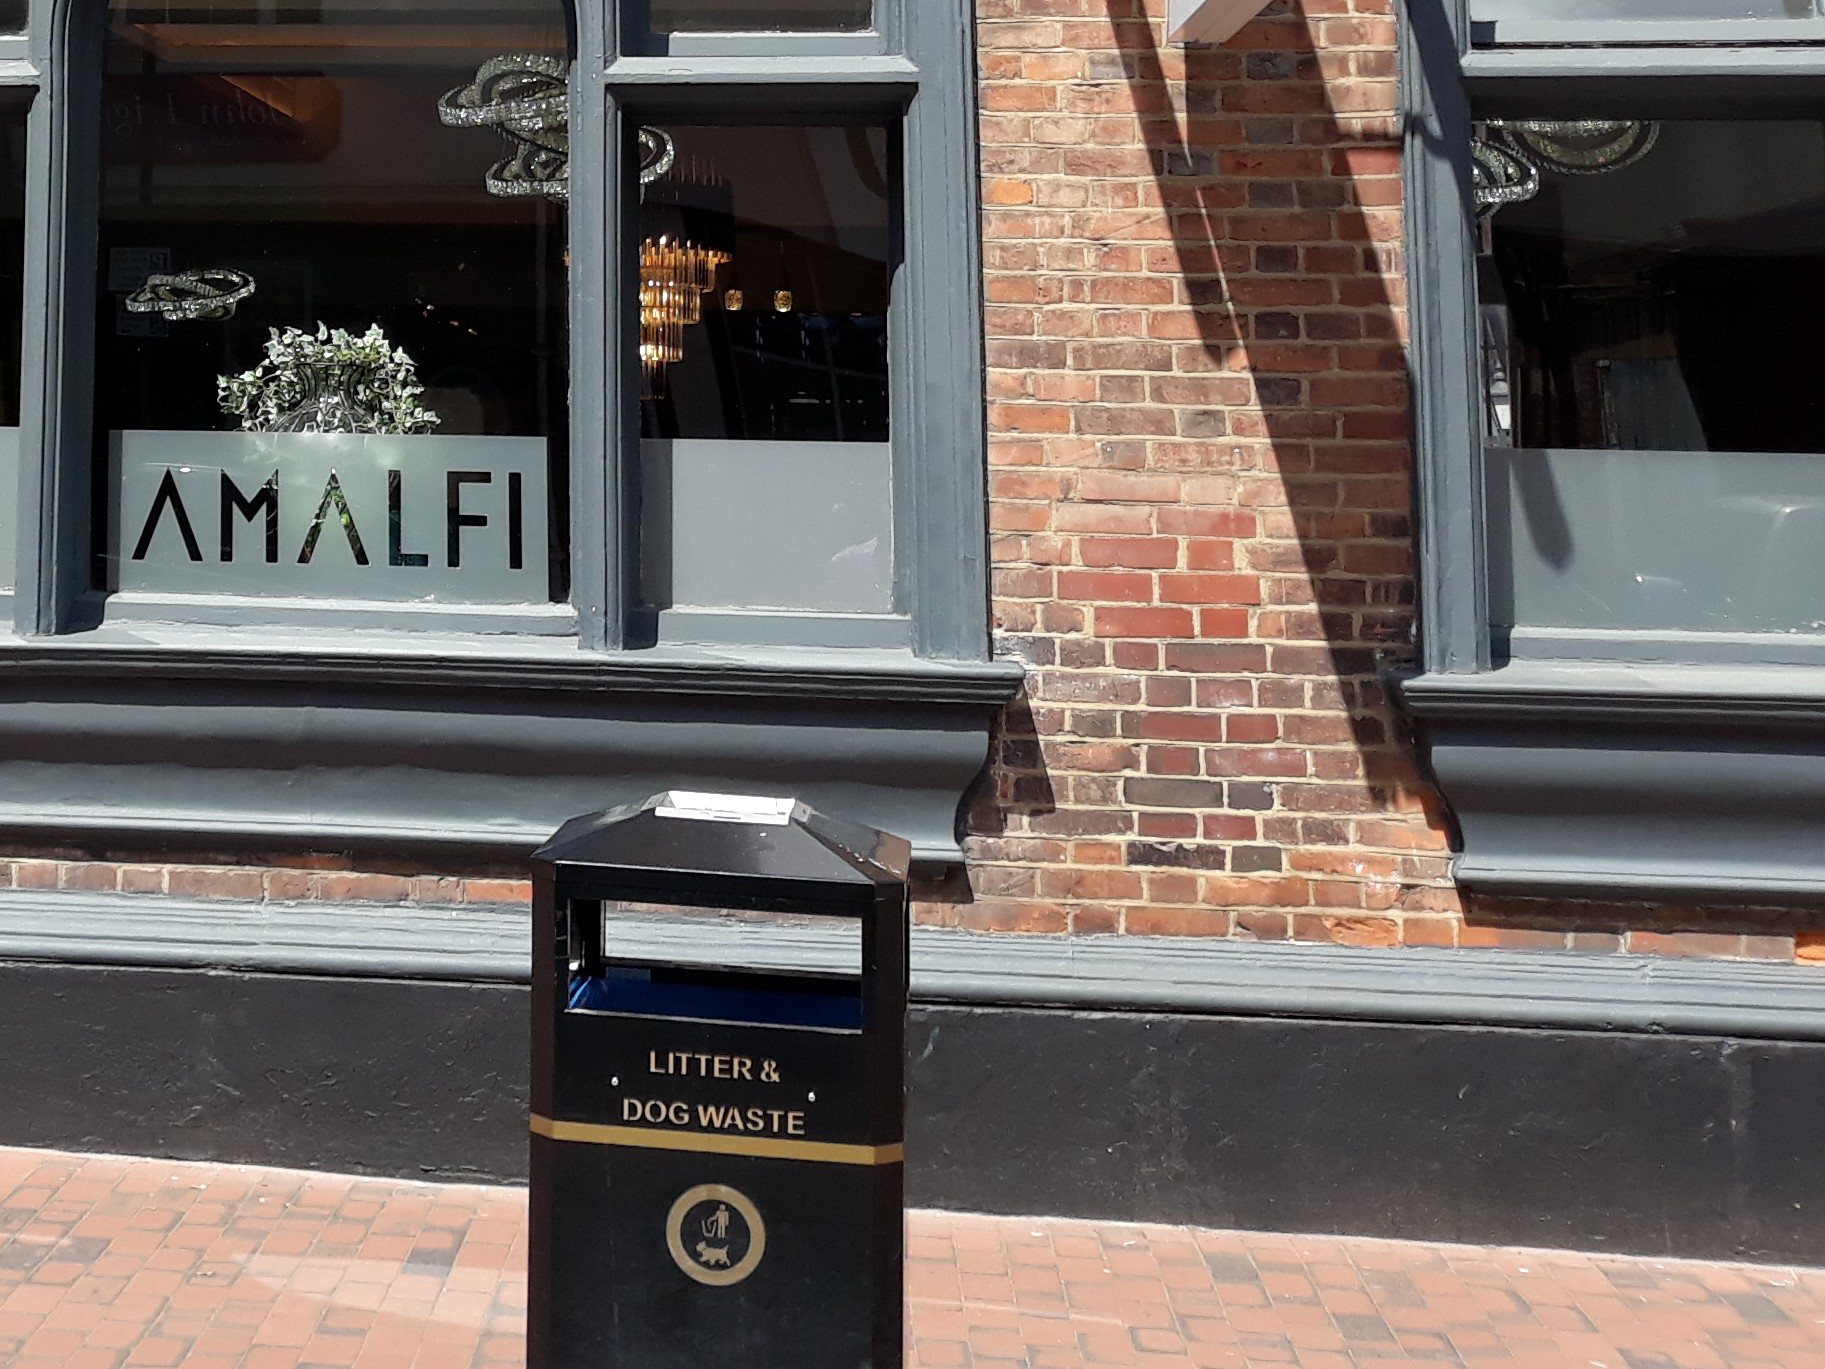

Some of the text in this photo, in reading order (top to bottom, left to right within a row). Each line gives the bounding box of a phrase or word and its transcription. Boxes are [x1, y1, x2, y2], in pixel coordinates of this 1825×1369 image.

[132, 467, 523, 570] AMALFI
[649, 1049, 781, 1083] LITTER &
[622, 1097, 806, 1136] DOG WASTE
